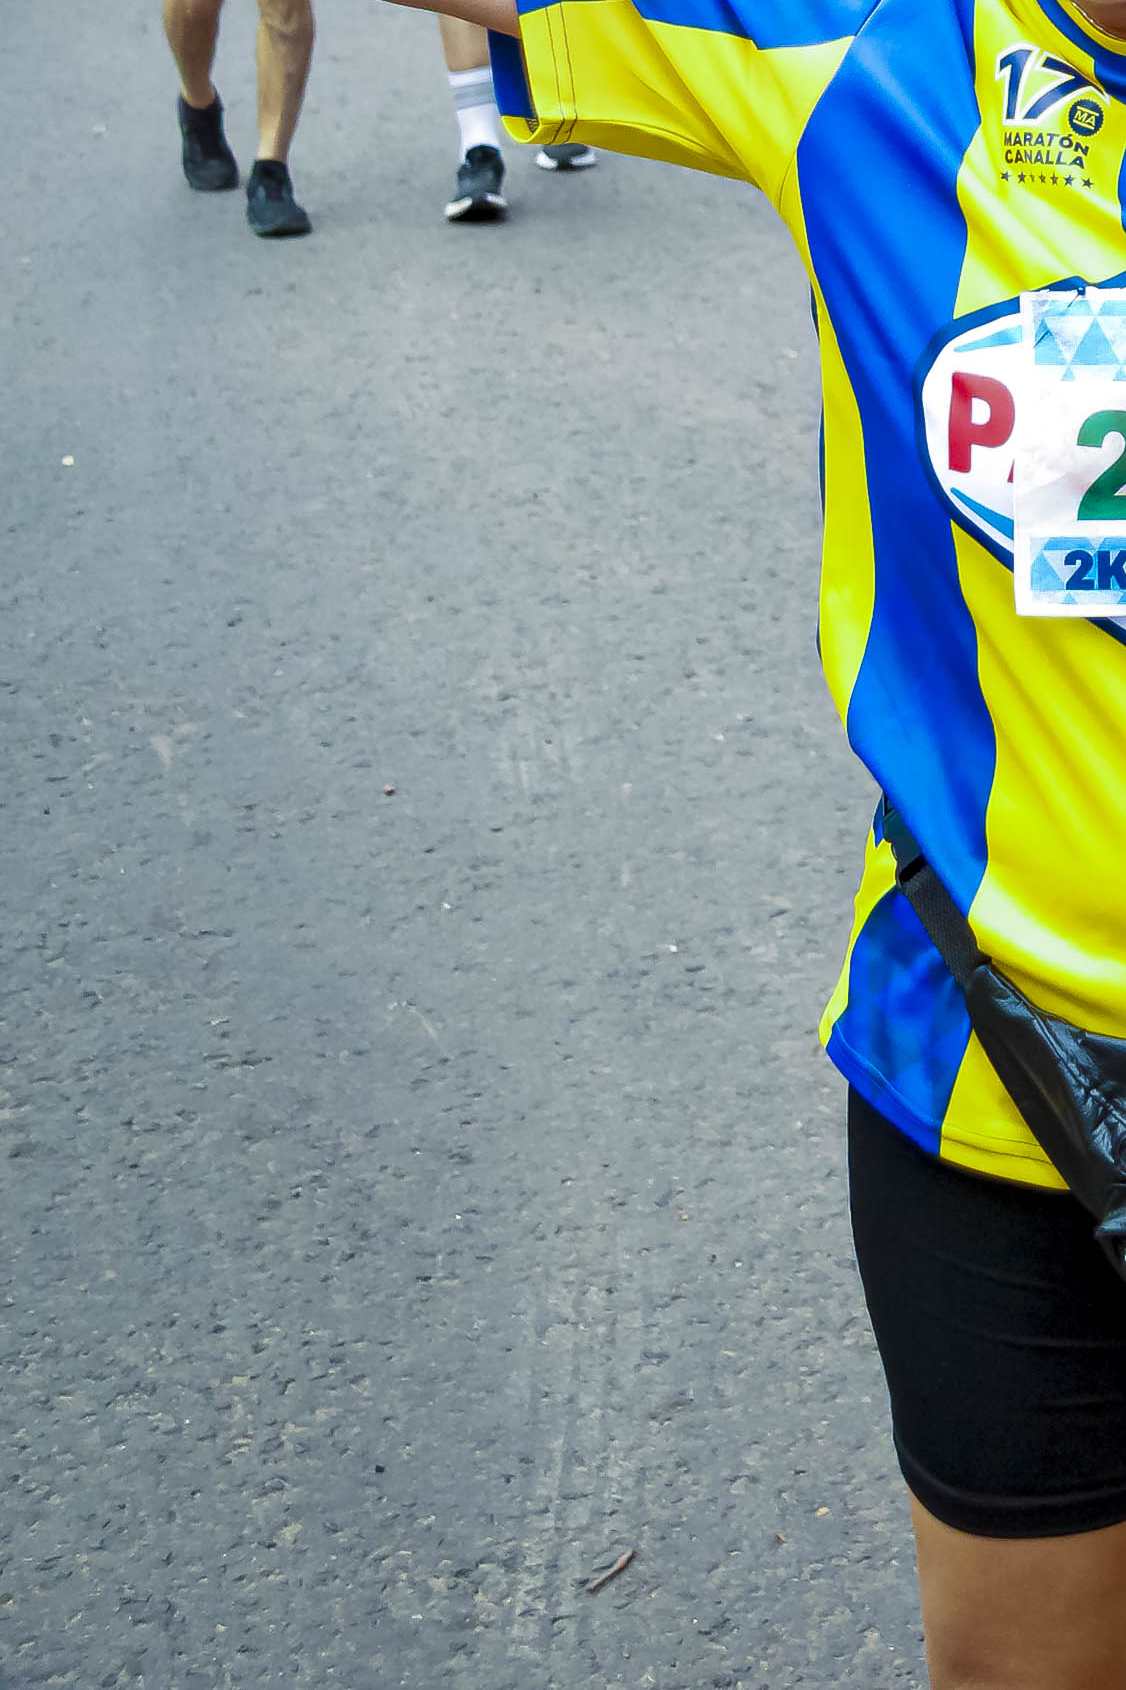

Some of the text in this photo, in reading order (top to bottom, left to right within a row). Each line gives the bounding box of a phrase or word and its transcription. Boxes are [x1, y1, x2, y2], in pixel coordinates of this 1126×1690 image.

[997, 45, 1107, 123] 17
[1075, 110, 1097, 127] MA
[1003, 131, 1089, 157] MARATÓN
[1004, 149, 1085, 170] CANALLA
